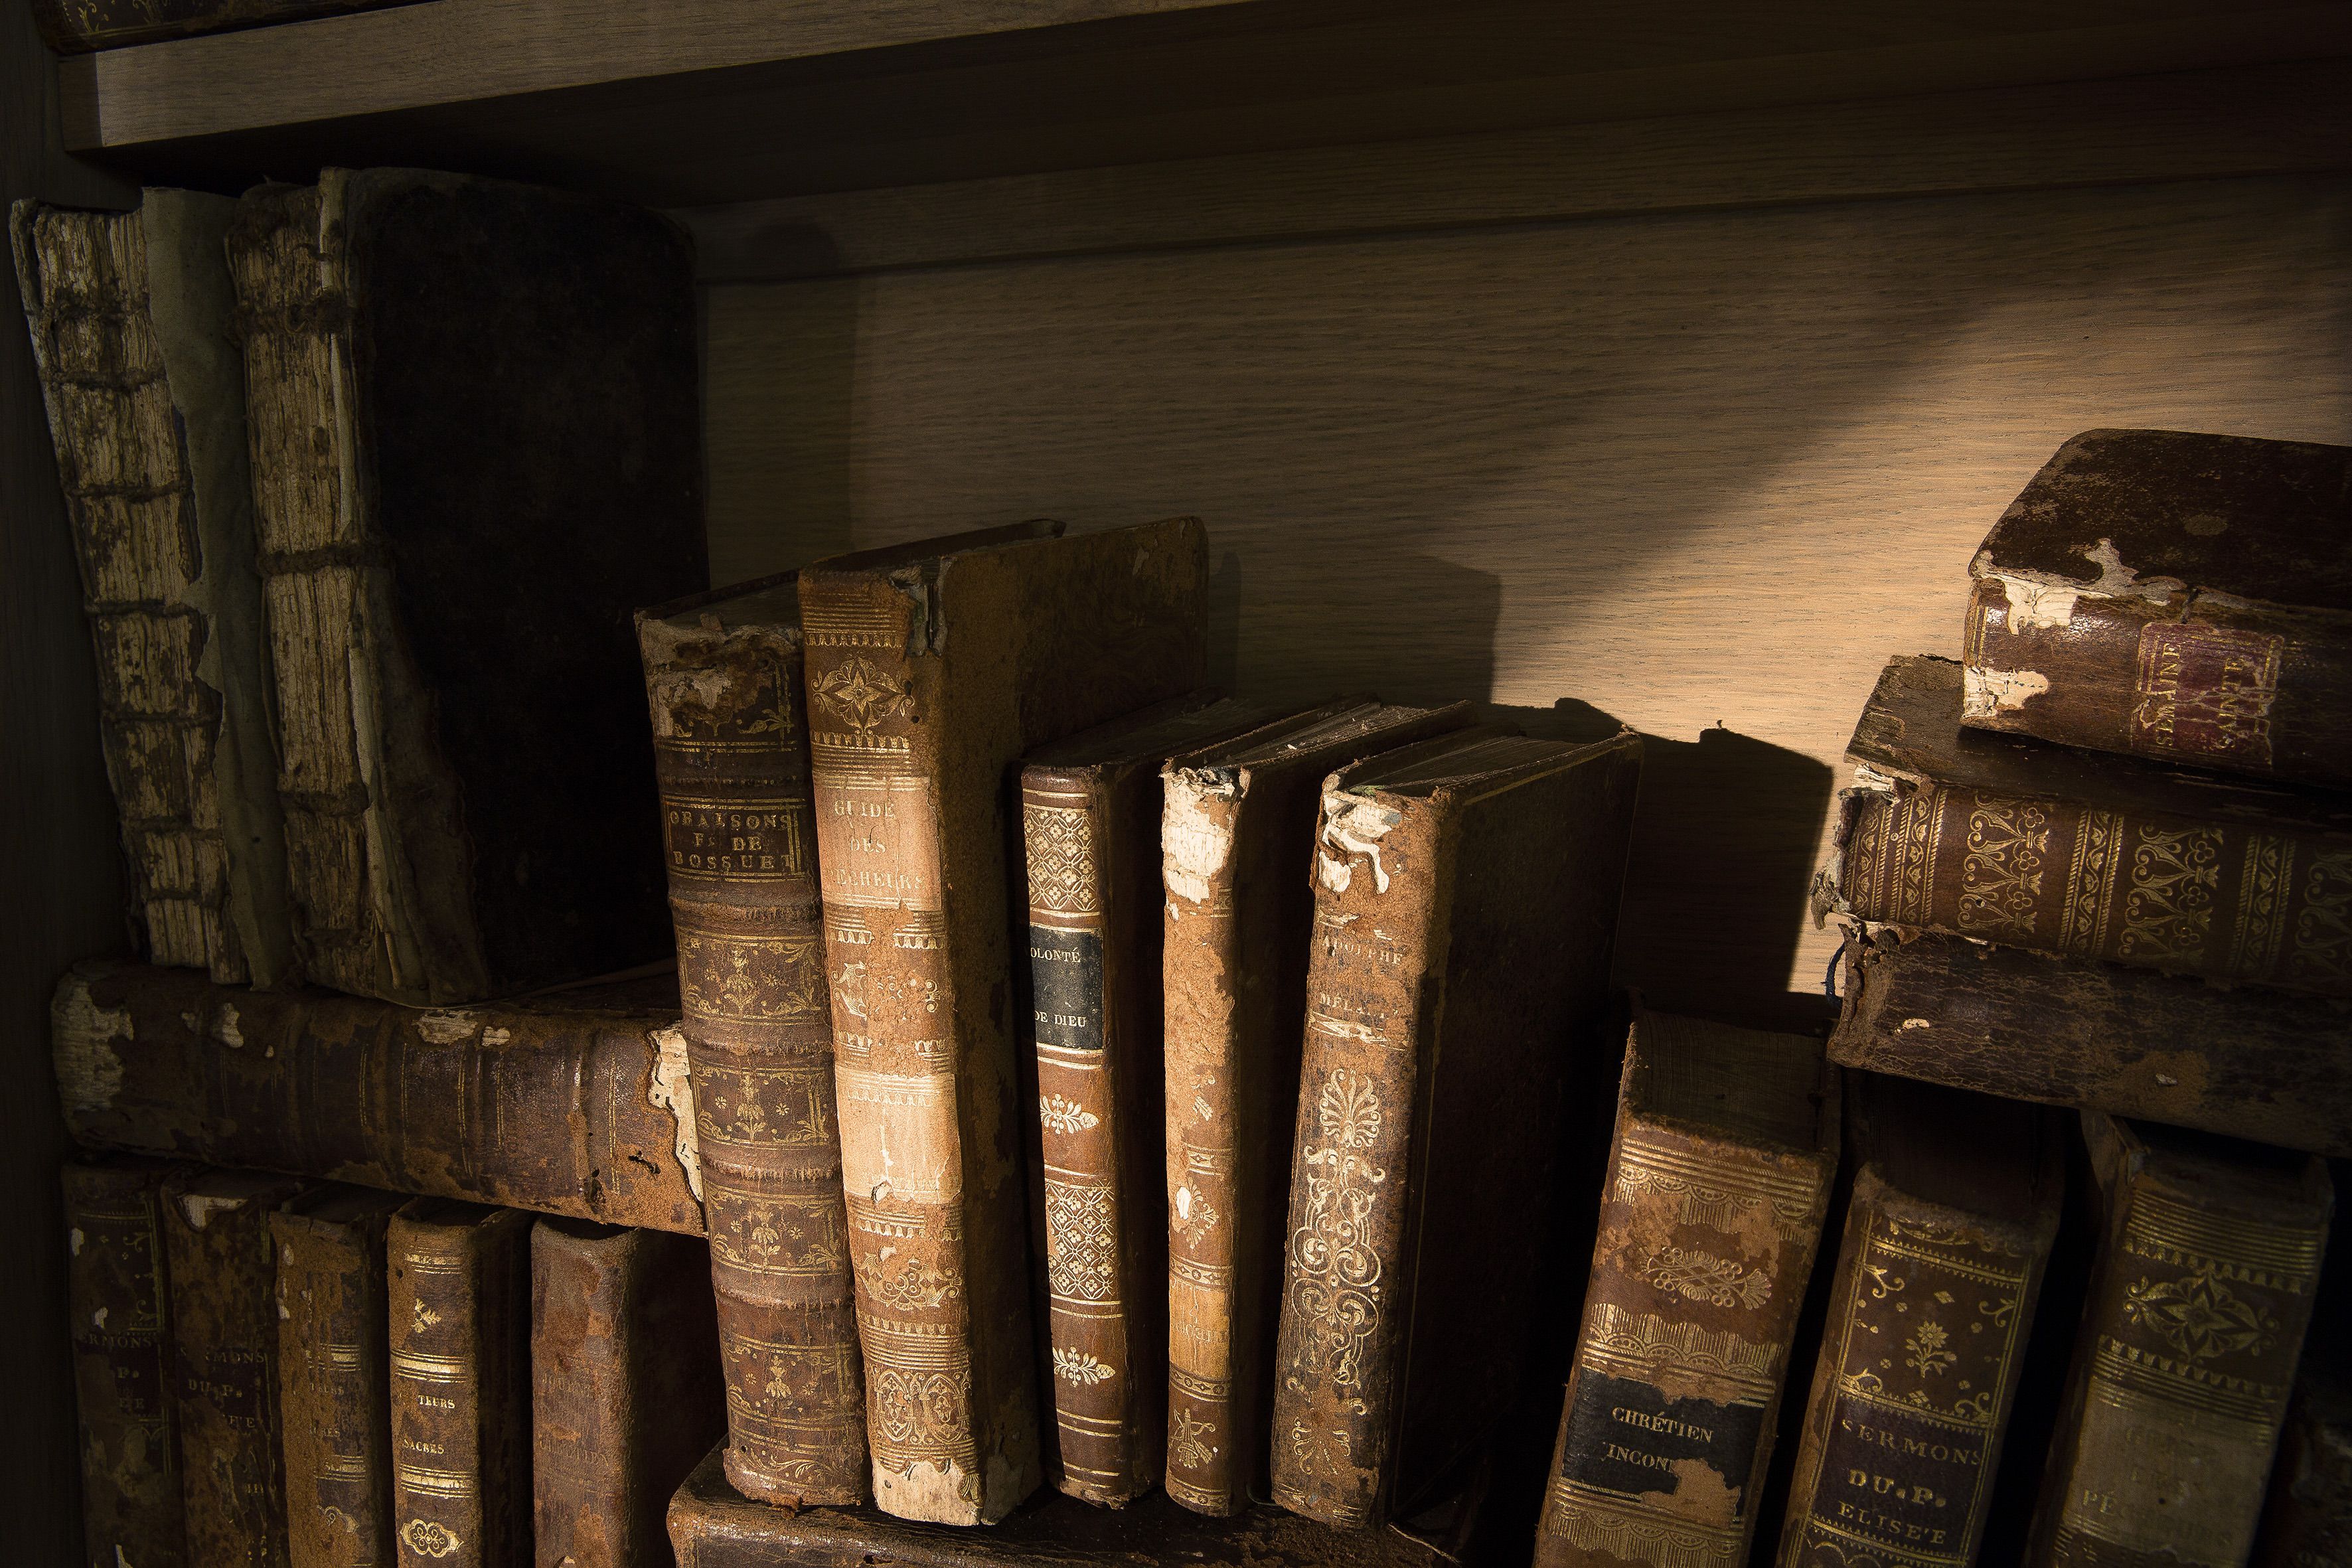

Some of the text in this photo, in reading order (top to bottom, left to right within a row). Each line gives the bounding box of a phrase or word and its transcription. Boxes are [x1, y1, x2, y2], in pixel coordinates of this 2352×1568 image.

[834, 799, 896, 819] GUIDE
[670, 811, 791, 830] ORAISONS
[1054, 1014, 1087, 1028] DIEU
[1612, 1406, 1713, 1443] CHRÉTIEN
